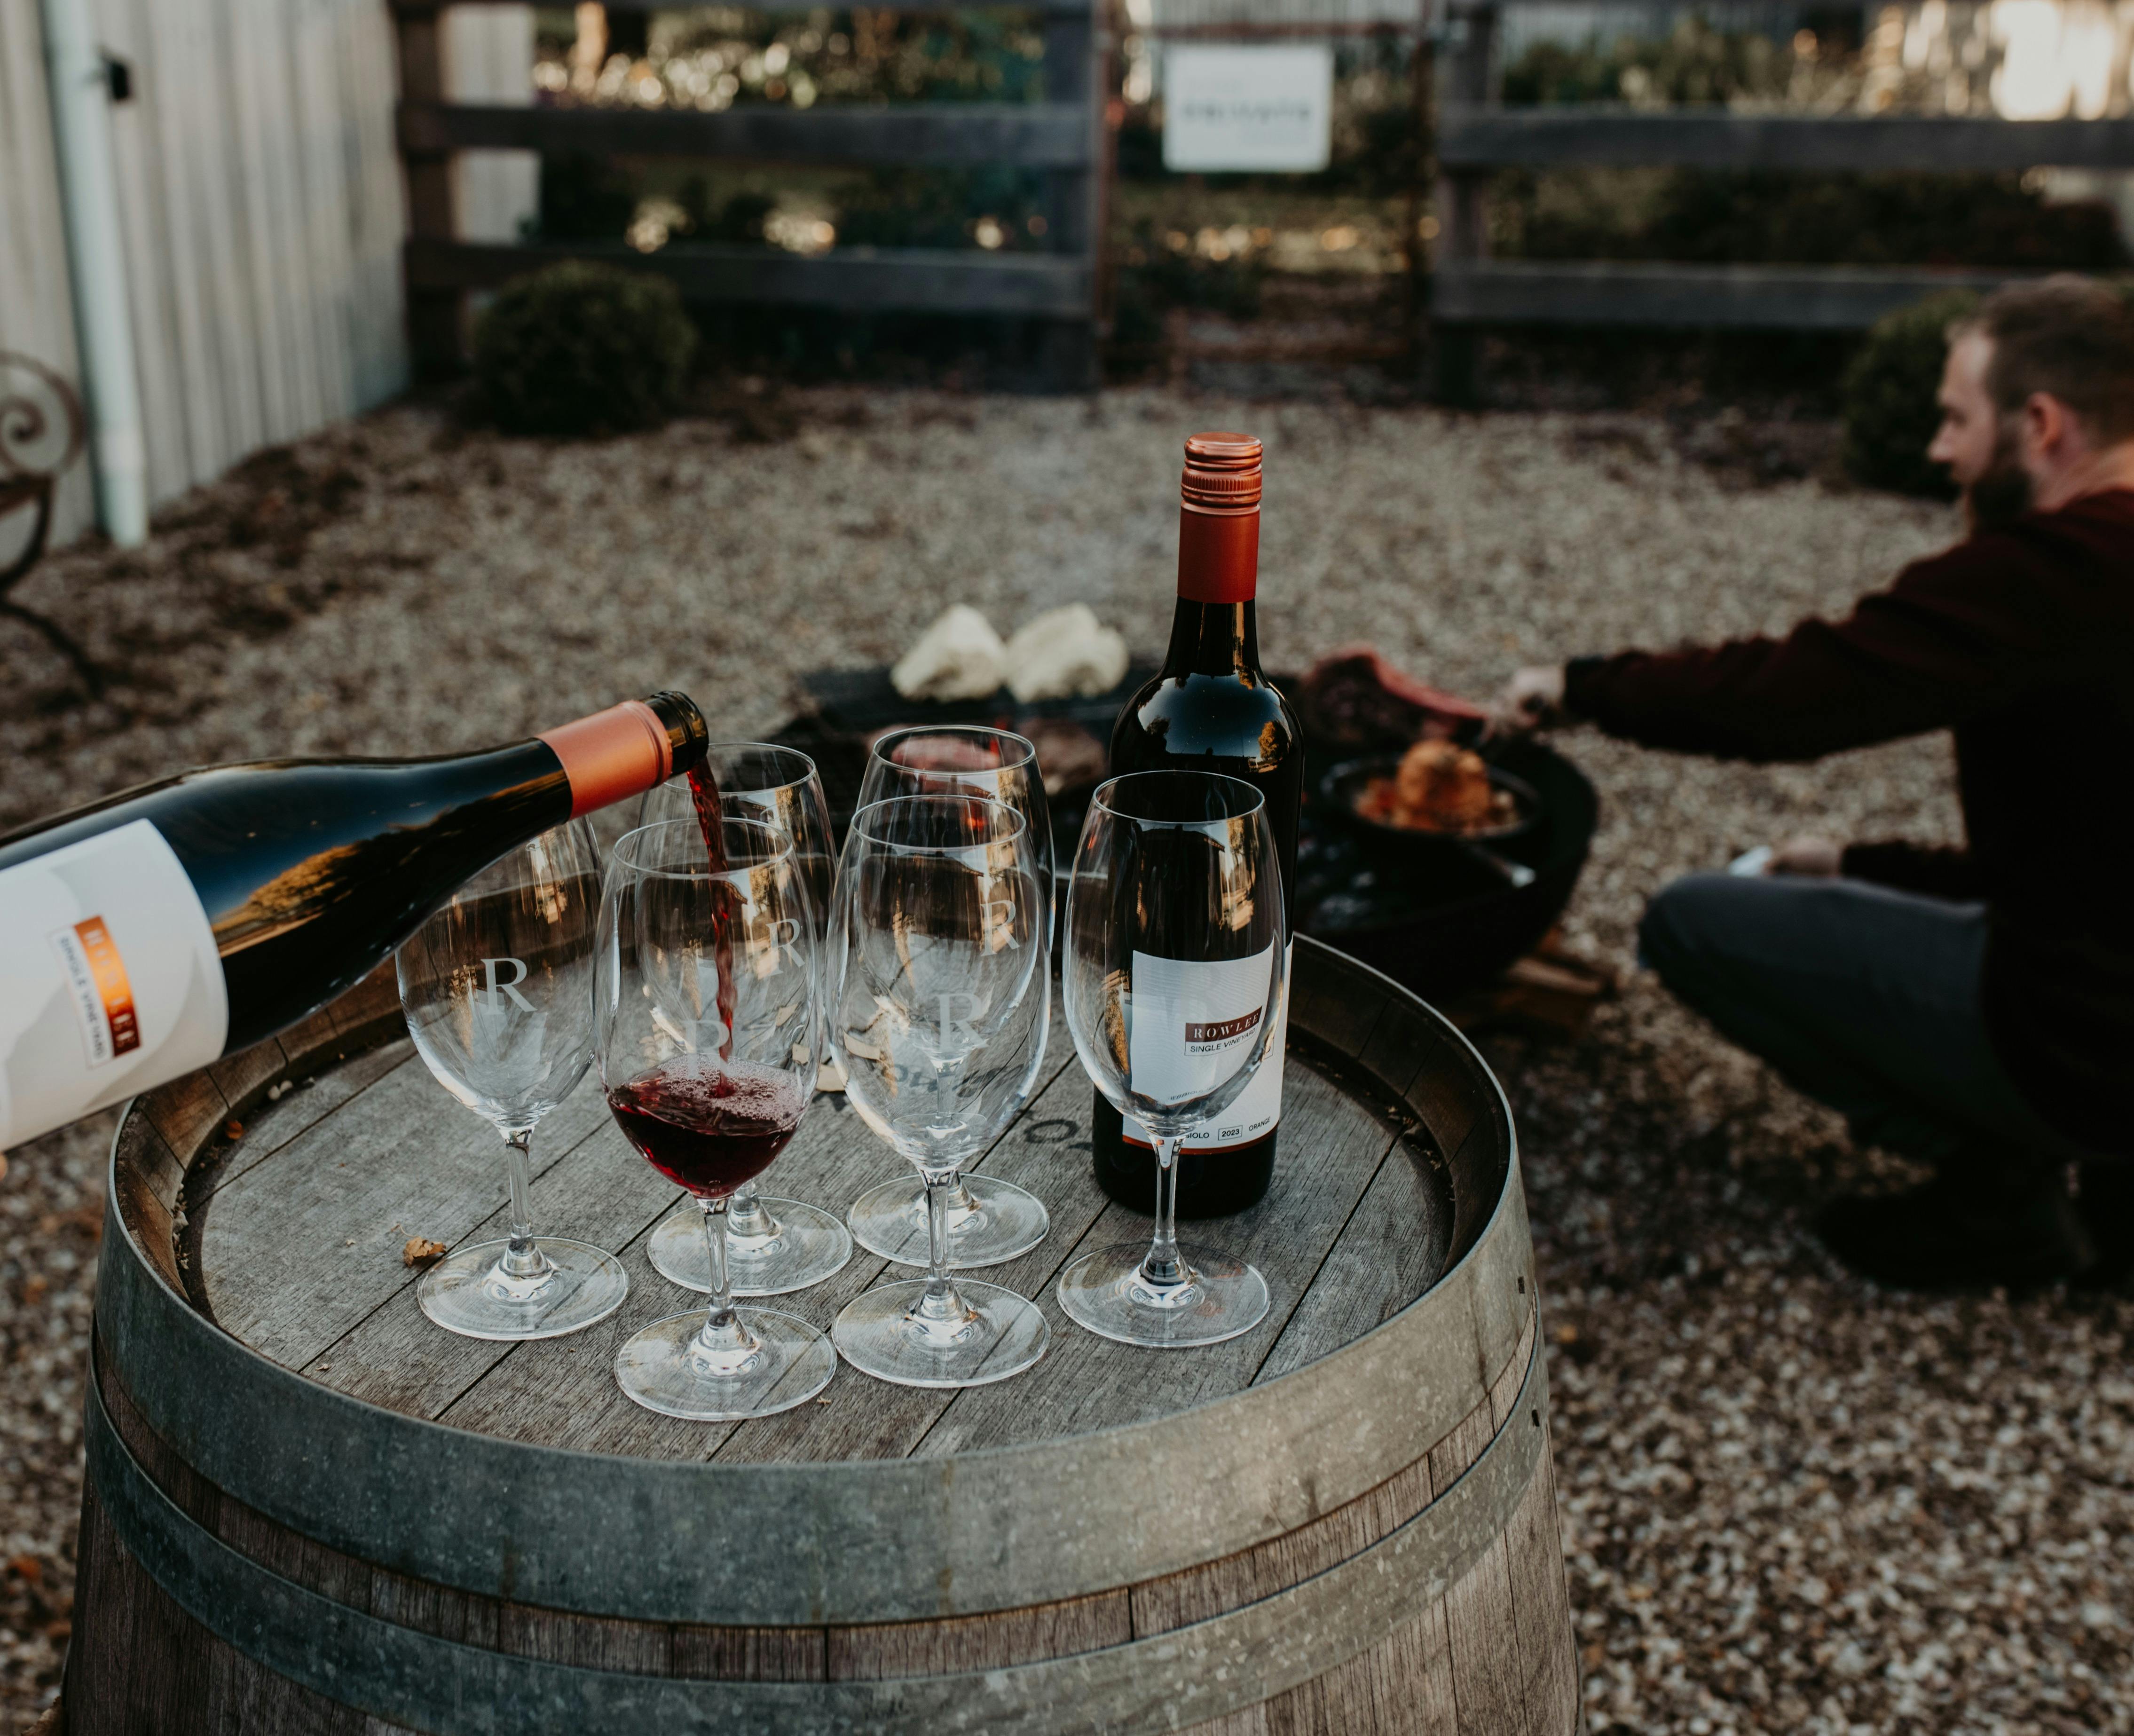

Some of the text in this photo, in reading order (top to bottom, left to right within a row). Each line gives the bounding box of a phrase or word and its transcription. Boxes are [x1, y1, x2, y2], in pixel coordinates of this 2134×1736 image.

[766, 918, 805, 975] R
[980, 900, 1020, 956] R
[480, 958, 538, 1015] R
[681, 1019, 734, 1079] R
[937, 993, 989, 1052] R
[1190, 1028, 1256, 1053] SINGLE VINEYARD
[1194, 1013, 1259, 1038] ROWLEE
[1222, 1128, 1240, 1137] 2023
[1249, 1116, 1270, 1132] ORANGE
